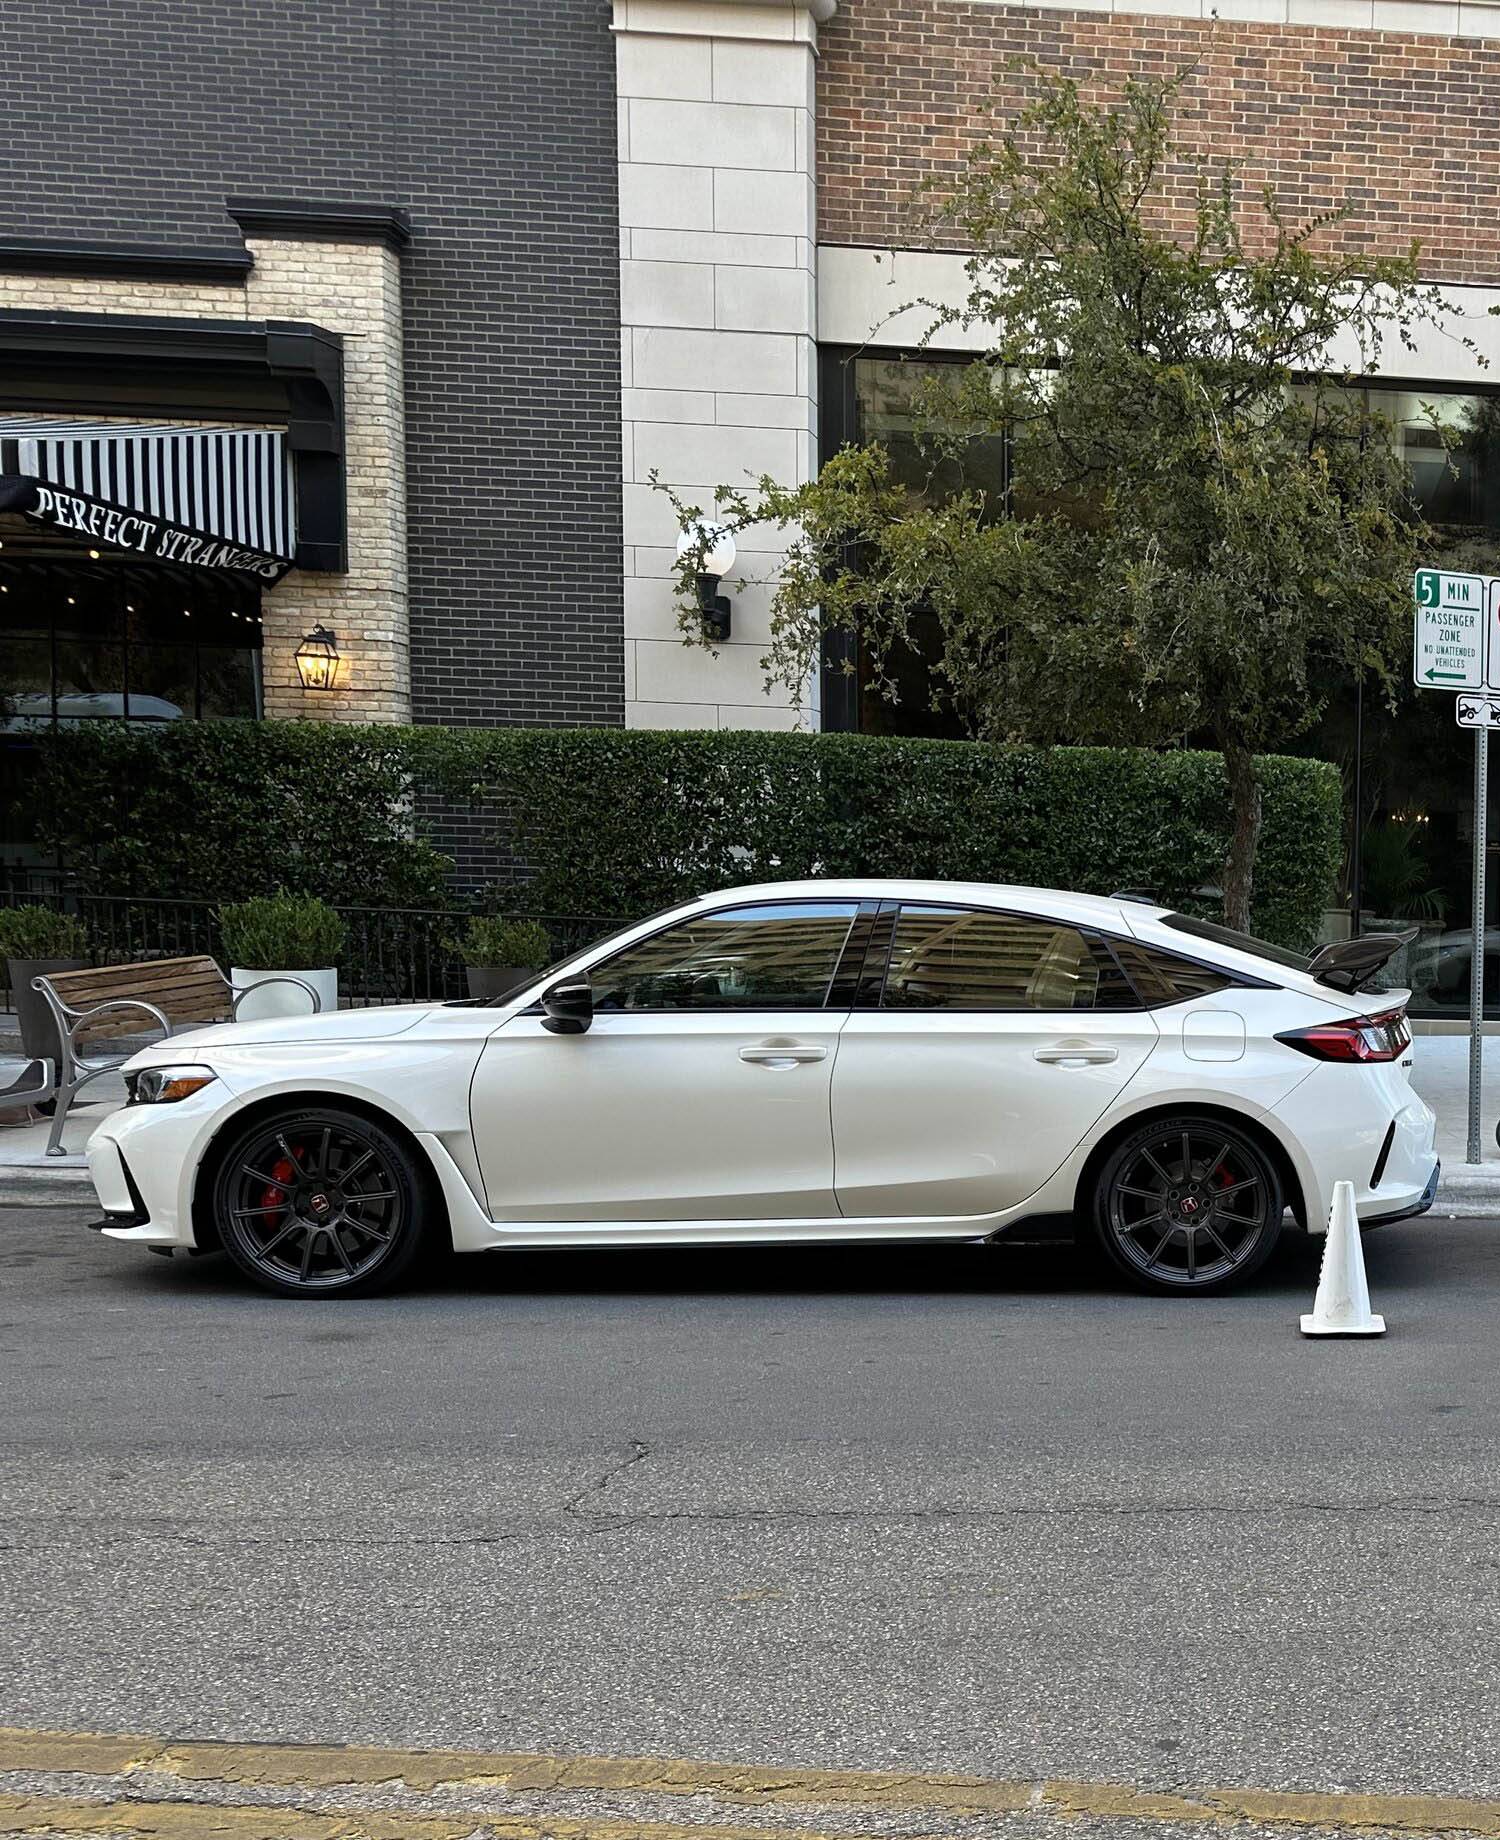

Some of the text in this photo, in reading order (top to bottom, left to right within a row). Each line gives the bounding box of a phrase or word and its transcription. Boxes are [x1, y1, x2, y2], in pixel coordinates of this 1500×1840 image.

[26, 487, 288, 579] PERFECT STRANGERS
[1421, 575, 1469, 605] 5 MIN
[1425, 611, 1475, 627] PASSENGER
[1439, 629, 1461, 642] ZONE
[1424, 644, 1476, 657] NO UNATTENDED
[1435, 658, 1465, 668] VEHICLES
